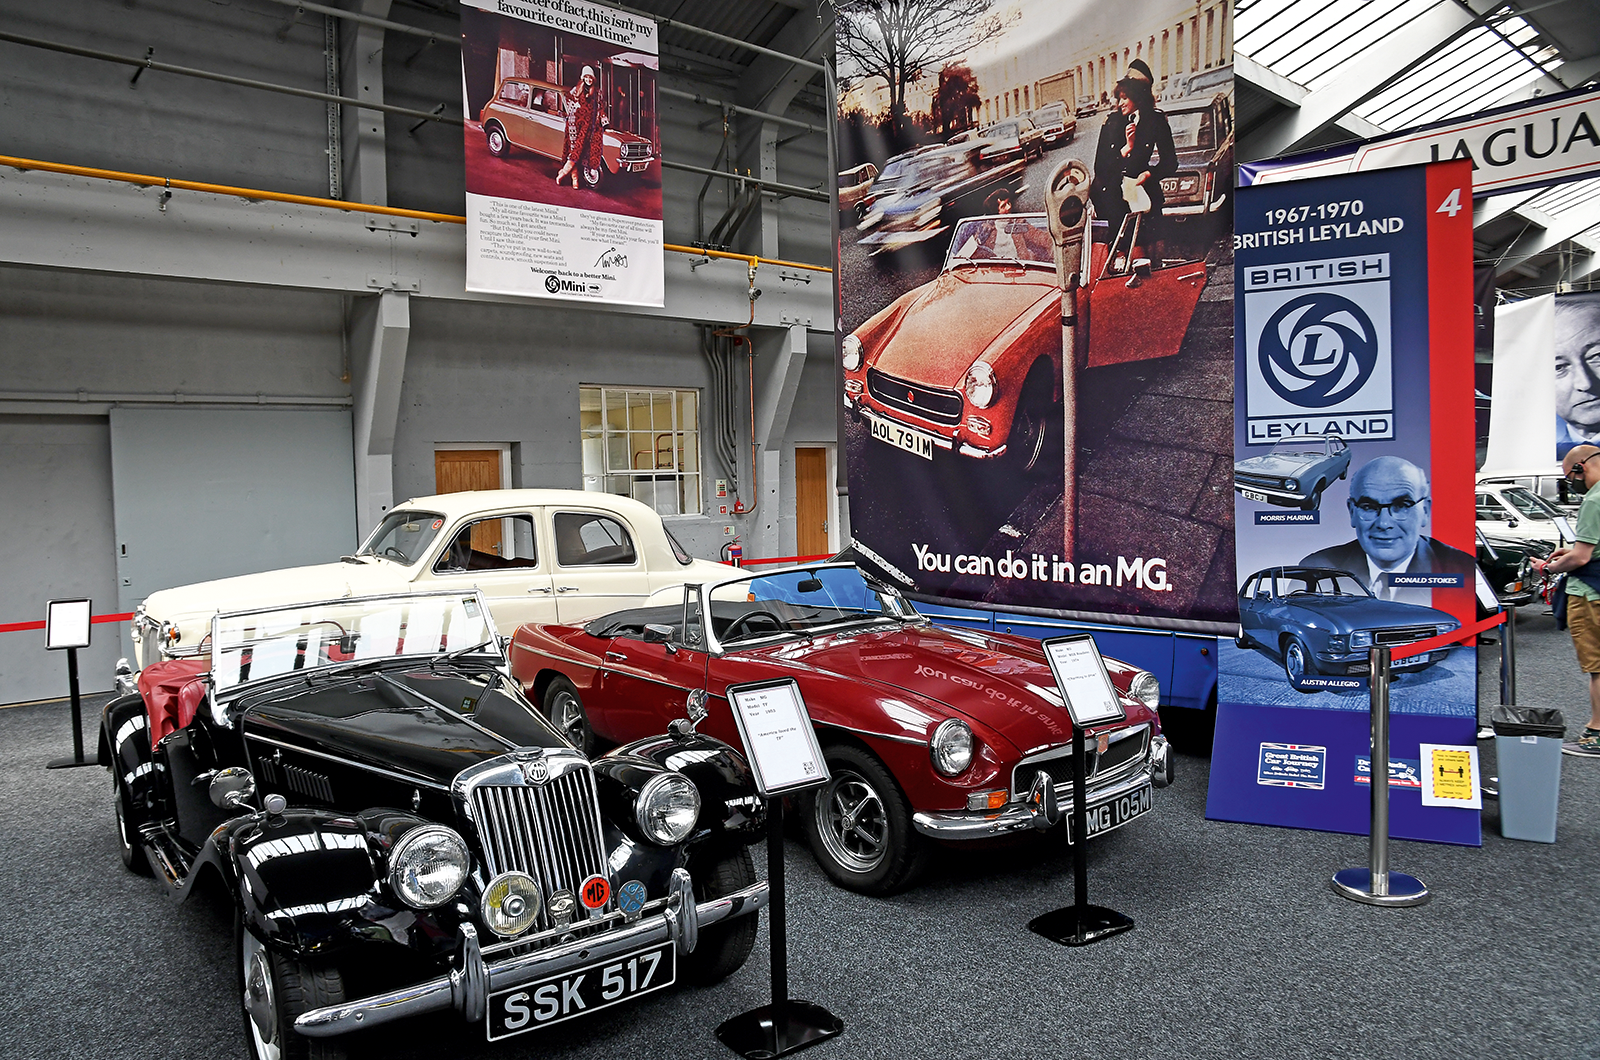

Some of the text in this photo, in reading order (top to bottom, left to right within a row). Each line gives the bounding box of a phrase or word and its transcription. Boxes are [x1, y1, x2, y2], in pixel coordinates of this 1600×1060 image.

[498, 0, 554, 24] favourite
[555, 16, 575, 30] car
[576, 21, 589, 33] of
[588, 23, 603, 37] all
[604, 27, 636, 45] time."
[550, 0, 564, 12] of
[564, 0, 588, 20] fact,
[588, 8, 610, 25] this
[611, 14, 634, 31] isn't
[635, 24, 653, 38] my
[1264, 200, 1364, 225] 1967-1970
[1435, 189, 1462, 217] 4
[1234, 216, 1404, 250] BRITISH LEYLAND
[1251, 258, 1382, 285] BRITISH
[561, 280, 585, 292] Mini
[873, 421, 930, 456] AOL 791M
[1251, 419, 1388, 438] LEYLAND
[1244, 491, 1264, 501] GBCJ
[912, 543, 1172, 592] You can do it in an MG.
[1265, 752, 1319, 762] Great British
[1282, 759, 1319, 769] Journey
[1115, 788, 1149, 824] 105M
[587, 882, 604, 902] MG
[504, 950, 661, 1030] SSK 517
